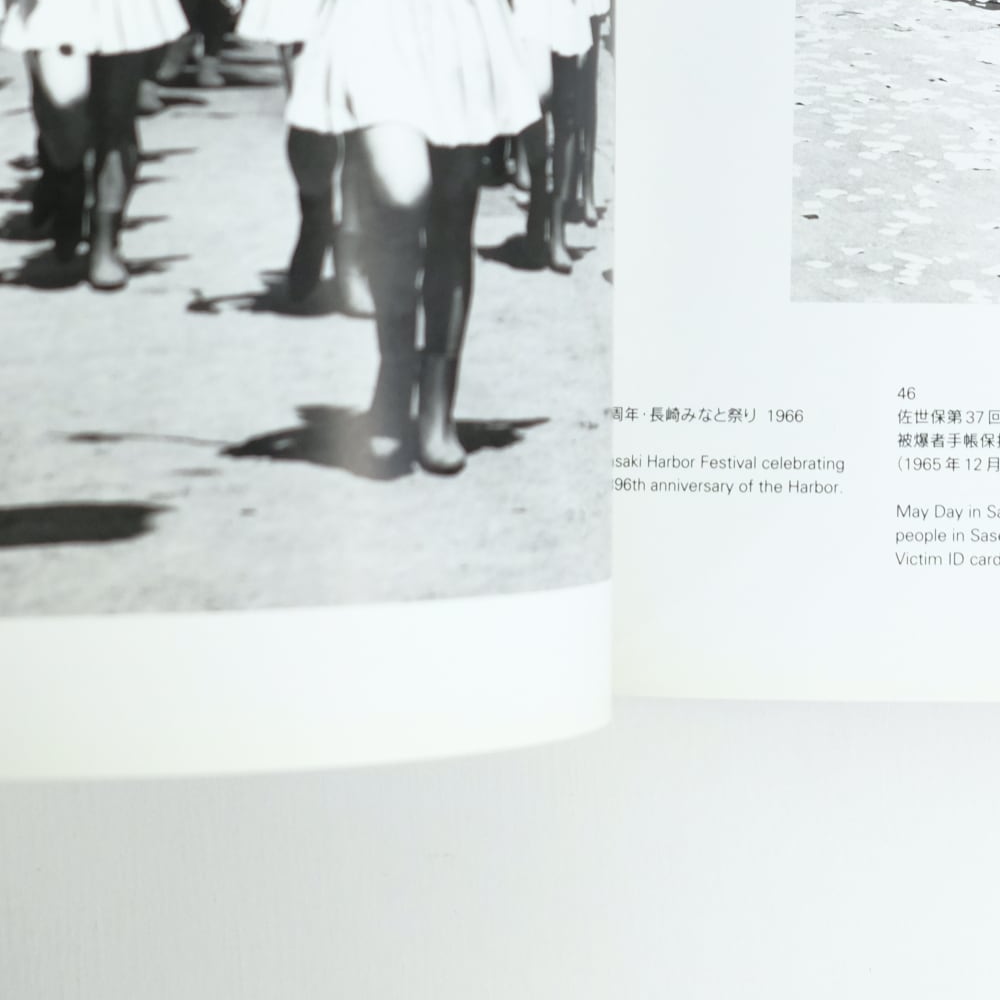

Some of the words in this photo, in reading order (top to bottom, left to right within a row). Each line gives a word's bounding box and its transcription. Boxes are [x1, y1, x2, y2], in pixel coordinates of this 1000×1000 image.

[897, 386, 916, 400] 46
[768, 409, 804, 423] 1966
[648, 454, 696, 470] Harbor
[701, 455, 757, 470] Festival
[762, 456, 845, 474] celebrating
[650, 478, 735, 496] anniversary
[739, 478, 754, 494] of
[759, 479, 783, 494] the
[788, 479, 843, 495] Harbor.
[896, 503, 929, 521] May
[935, 503, 963, 521] Day
[969, 504, 981, 519] in
[895, 528, 948, 544] people
[953, 527, 965, 543] in
[895, 551, 943, 566] Victim
[949, 552, 965, 567] ID
